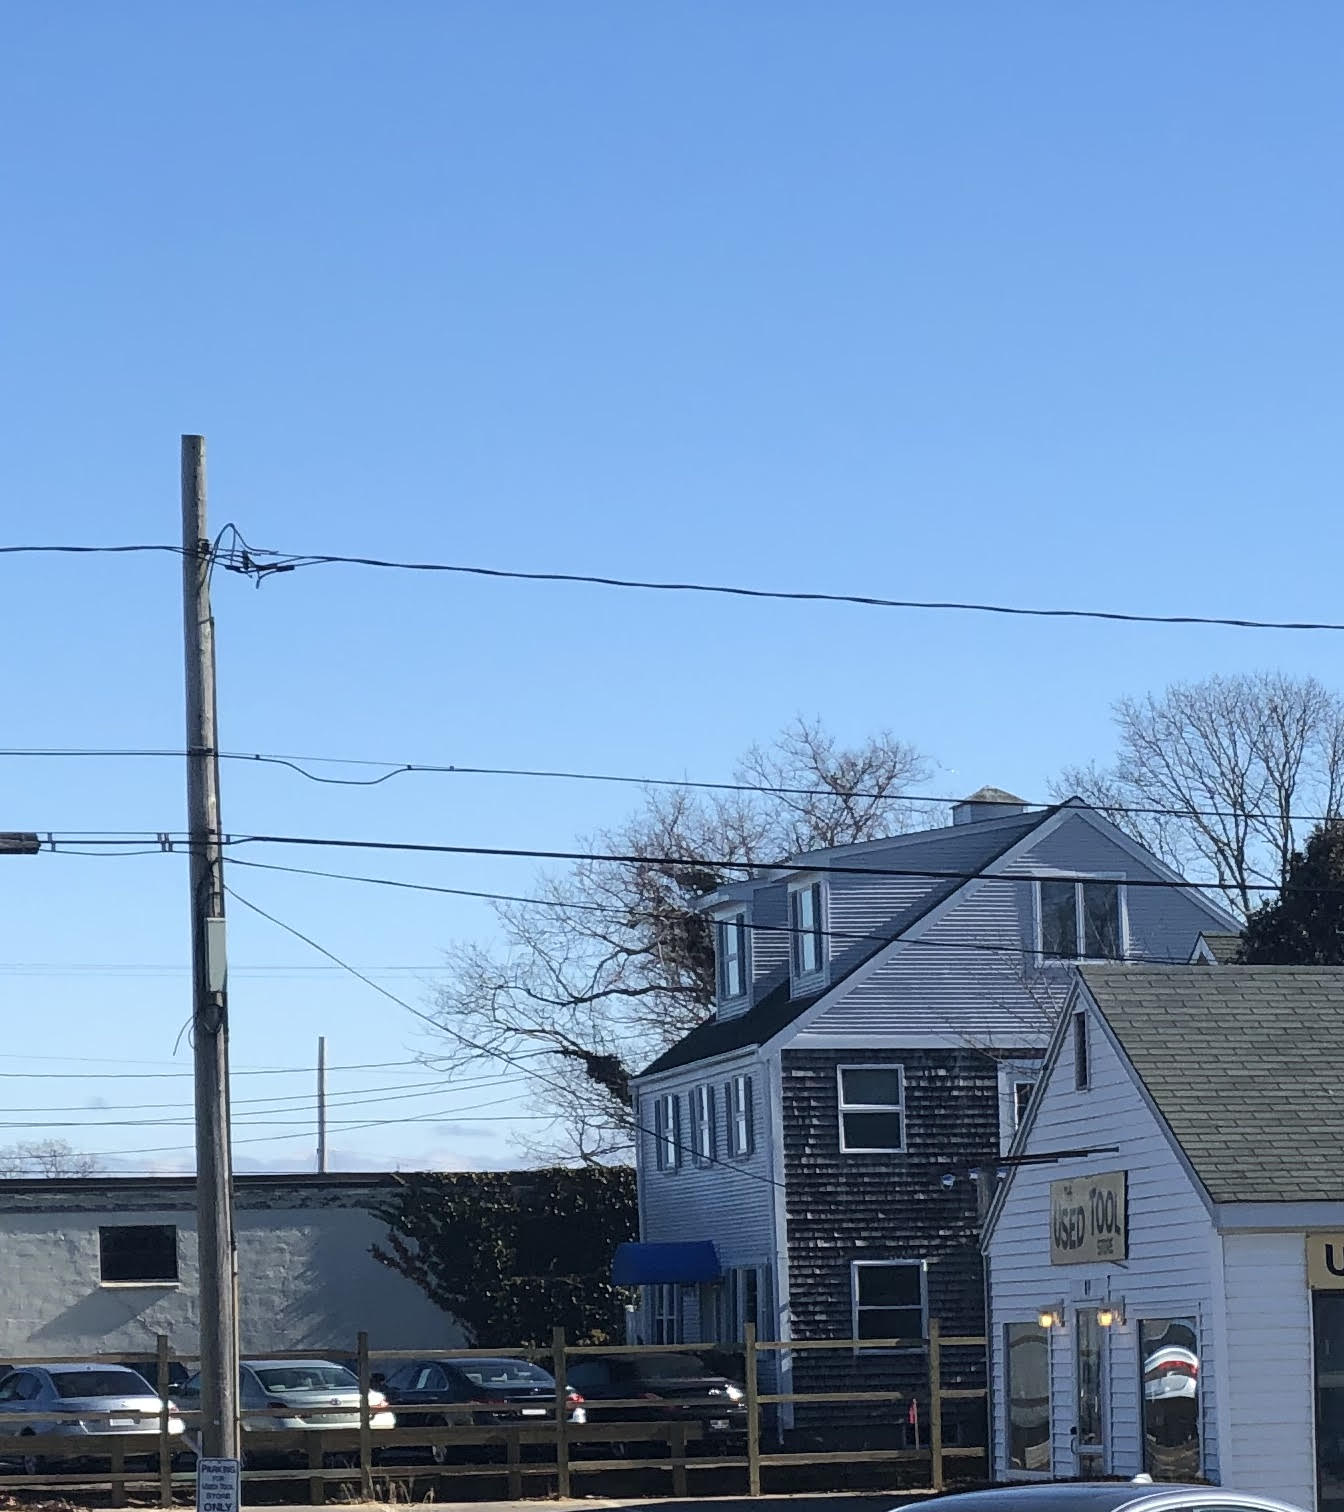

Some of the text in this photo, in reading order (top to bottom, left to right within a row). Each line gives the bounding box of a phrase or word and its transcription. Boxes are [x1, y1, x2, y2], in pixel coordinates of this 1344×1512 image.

[1054, 1187, 1121, 1251] USED TOOL
[203, 1502, 233, 1512] ONLY
